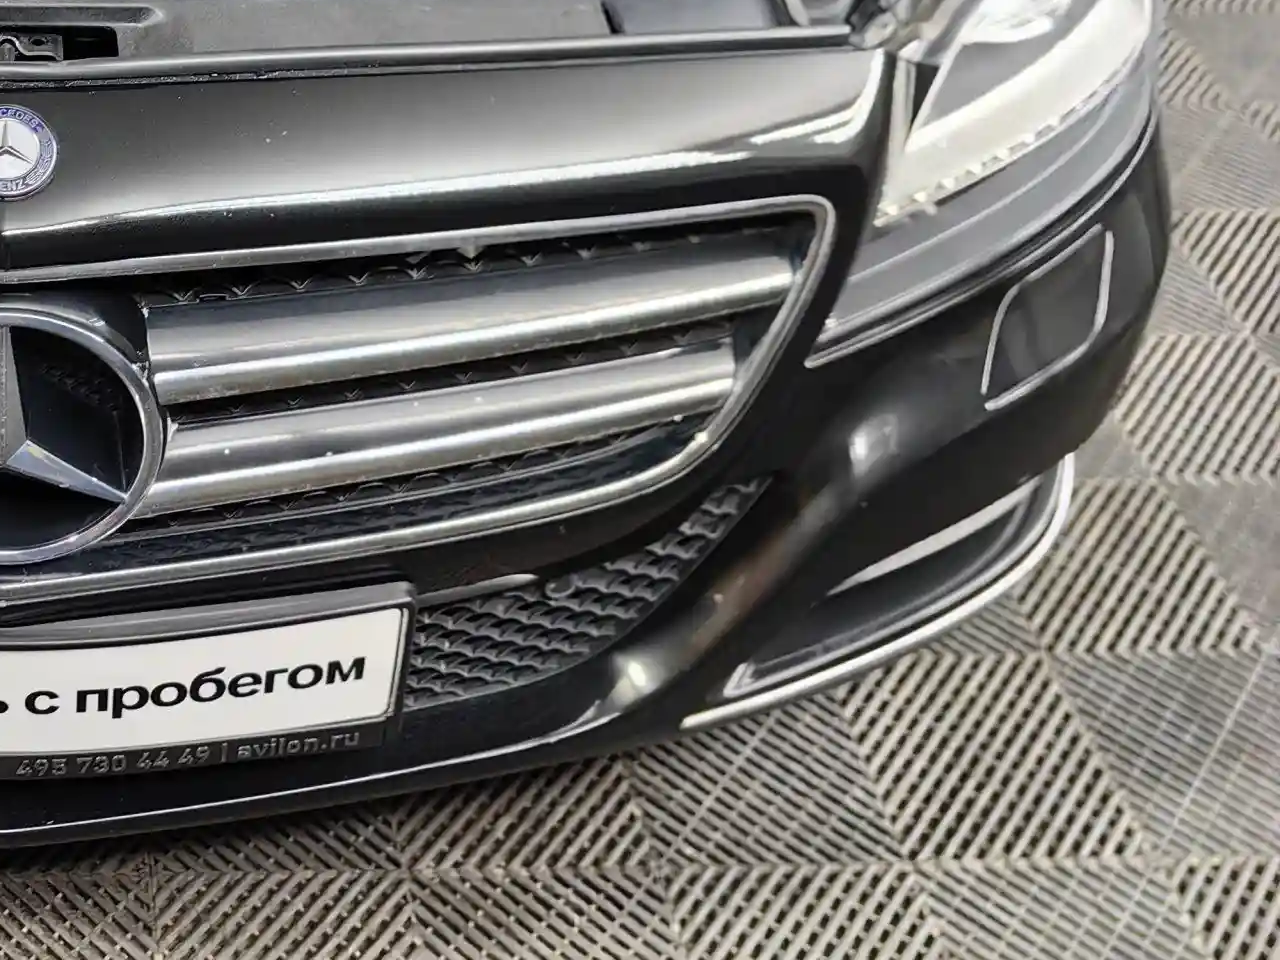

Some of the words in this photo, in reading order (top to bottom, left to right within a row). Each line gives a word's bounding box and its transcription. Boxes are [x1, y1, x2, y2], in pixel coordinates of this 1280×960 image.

[24, 690, 60, 715] с
[75, 656, 367, 719] пробегом
[15, 756, 67, 777] 495
[76, 753, 127, 775] 730
[136, 750, 170, 771] 44
[177, 745, 211, 767] 49
[237, 730, 360, 760] avilon.ru
